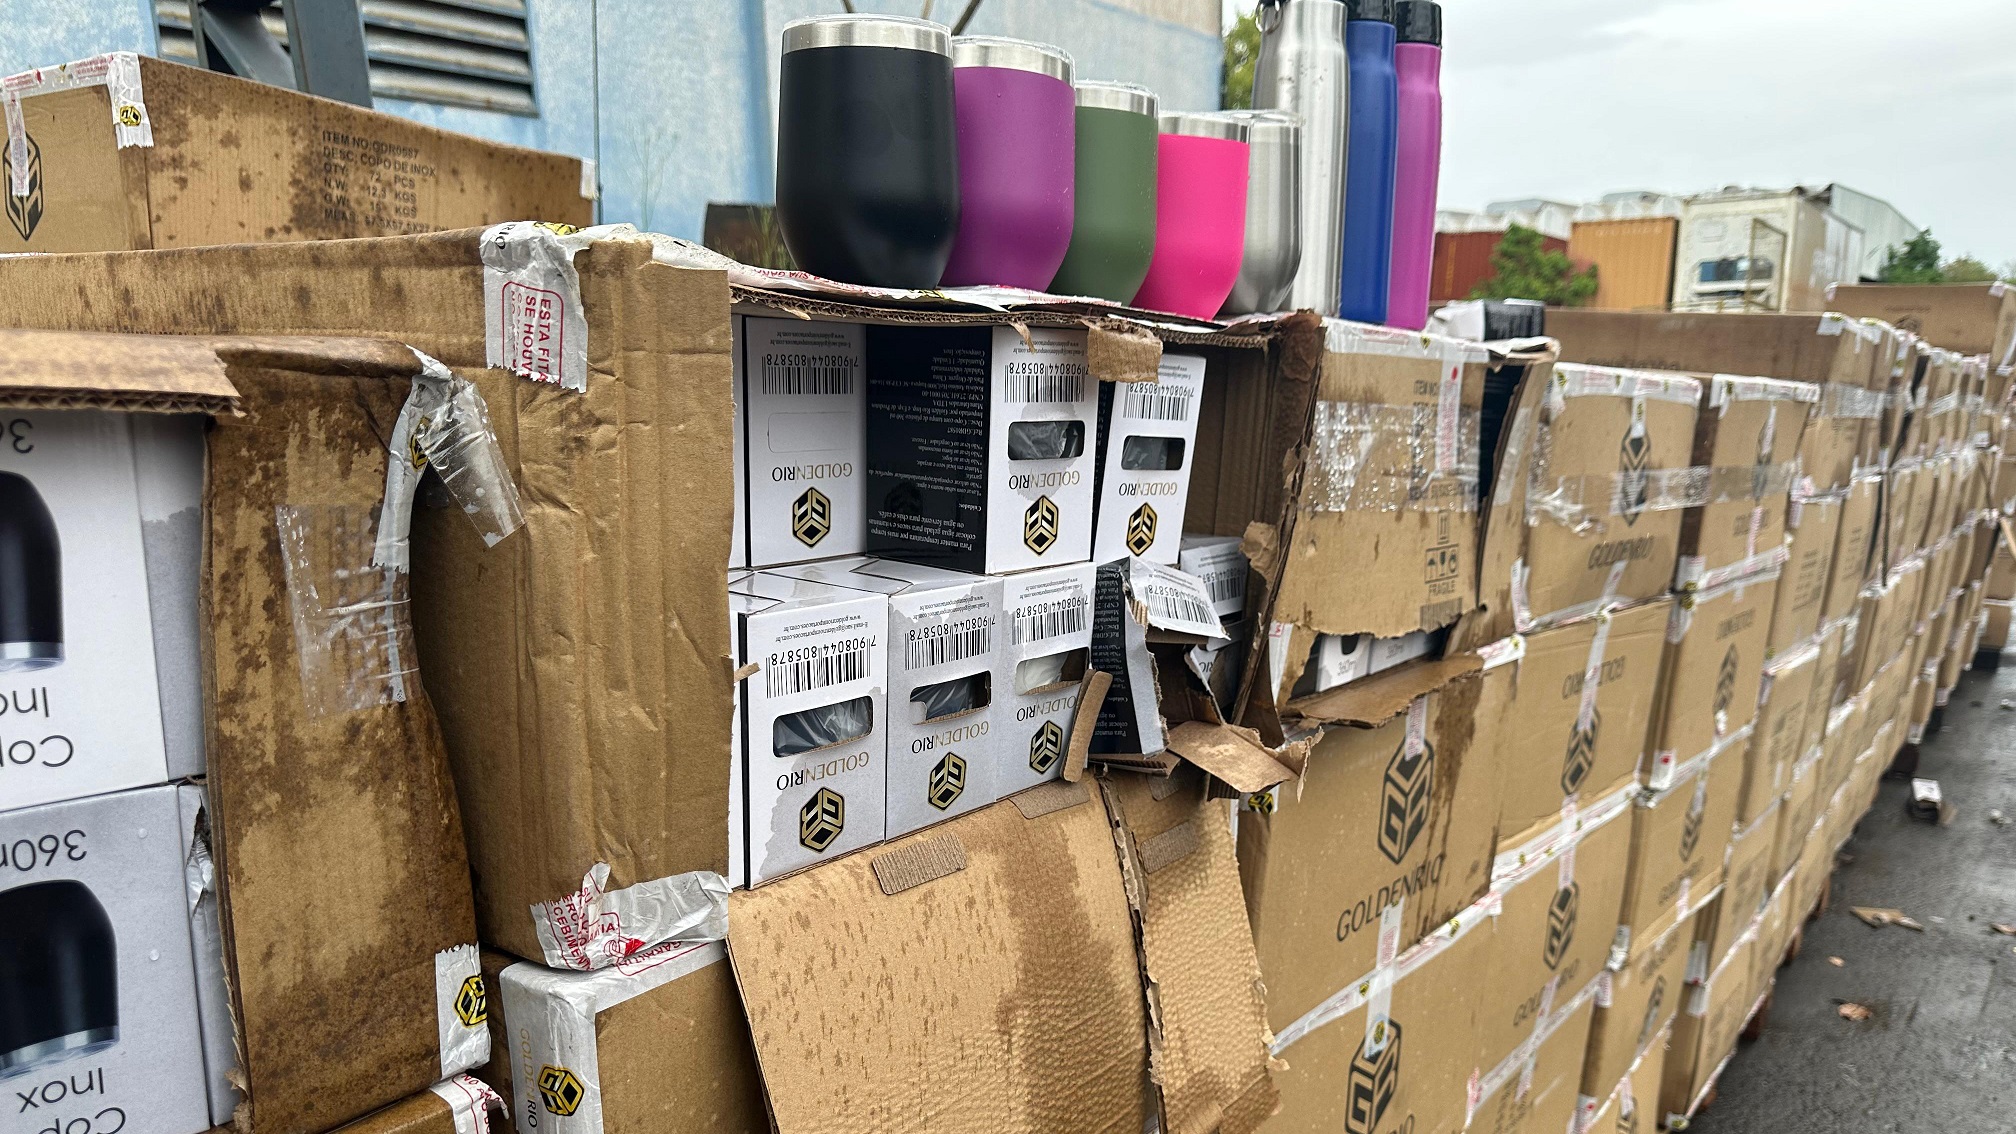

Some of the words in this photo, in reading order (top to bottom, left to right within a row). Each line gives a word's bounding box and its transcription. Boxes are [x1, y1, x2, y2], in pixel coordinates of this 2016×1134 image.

[323, 130, 349, 145] ITEM
[360, 153, 391, 169] COPO
[394, 161, 408, 173] DE
[411, 163, 436, 177] INOX
[394, 175, 415, 189] PCS
[395, 192, 416, 204] KGS
[395, 206, 417, 218] KGS
[524, 295, 536, 318] SE
[538, 298, 551, 342] ESTA
[766, 354, 806, 366] 805878
[812, 355, 848, 367] 908044
[854, 356, 858, 367] 7
[1009, 362, 1044, 375] 805878
[1049, 363, 1081, 375] 908044
[1129, 383, 1157, 394] 805878
[1161, 385, 1187, 396] 908044
[1190, 387, 1194, 397] 7
[959, 410, 983, 418] Importado
[772, 462, 852, 481] GOLDENRIO
[1009, 470, 1080, 490] GOLDENRIO
[1119, 482, 1177, 496] GOLDENRIO
[878, 511, 892, 519] cafés.
[897, 514, 908, 522] chás
[869, 519, 892, 527] vitaminas
[921, 517, 942, 526] fervente
[871, 528, 886, 536] tempo
[912, 524, 923, 532] para
[924, 527, 941, 535] gelada
[909, 535, 939, 545] temperatura
[960, 542, 972, 551] Para
[1052, 596, 1080, 609] 908044
[1085, 595, 1088, 605] 7
[1016, 603, 1048, 618] 805878
[954, 616, 987, 630] 908044
[991, 614, 995, 624] 7
[910, 623, 949, 641] 805878
[823, 636, 865, 655] 908044
[871, 635, 876, 646] 7
[771, 645, 817, 666] 805878
[911, 721, 989, 753] GOLDENRIO
[776, 751, 869, 790] GOLDENRIO
[521, 1028, 537, 1128] GOLDENRIO
[16, 1066, 106, 1114] Inox
